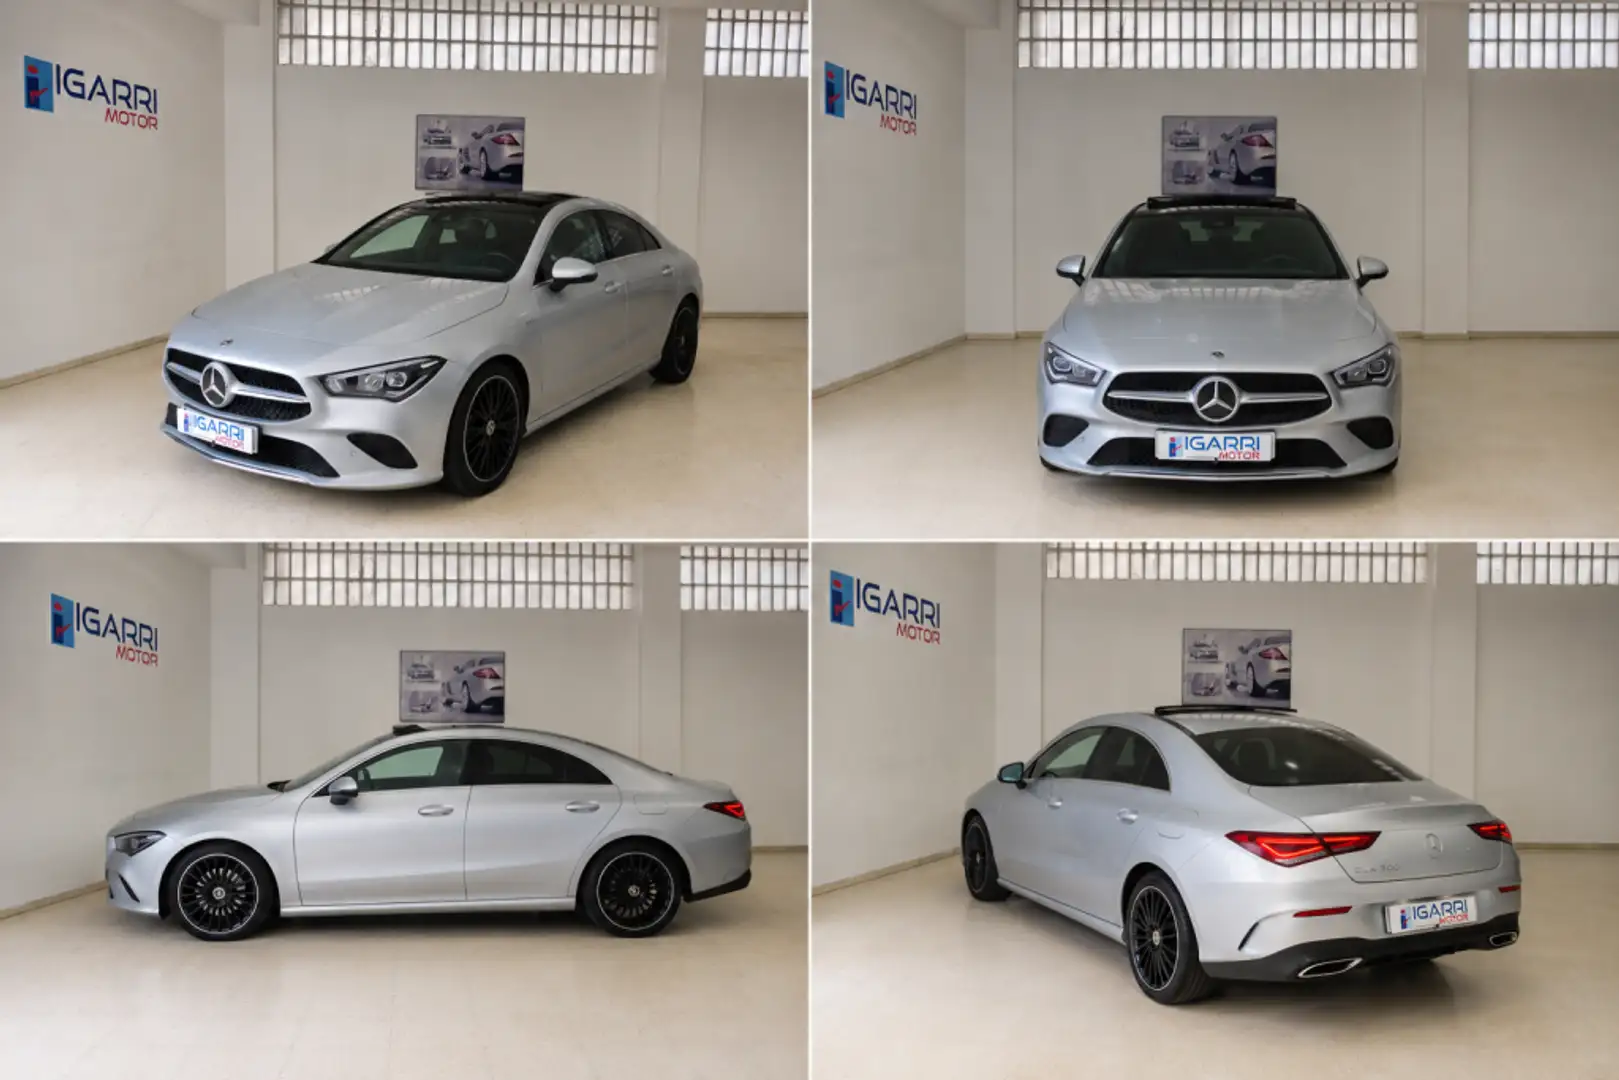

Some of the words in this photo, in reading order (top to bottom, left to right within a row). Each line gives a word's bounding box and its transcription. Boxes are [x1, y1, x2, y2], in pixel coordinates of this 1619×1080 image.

[55, 63, 158, 114] IGARRI
[846, 69, 917, 120] IGARRI
[104, 107, 159, 131] MOTOR
[880, 113, 917, 136] MOTOR
[193, 414, 245, 441] IGARRI
[1184, 435, 1260, 451] IGARRI
[1219, 450, 1260, 461] MOTOR
[855, 577, 941, 629] IGARRI
[75, 601, 158, 652] IGARRI
[896, 621, 941, 645] MOTOR
[115, 644, 159, 668] MOTOR
[1412, 898, 1468, 921] IGARRI
